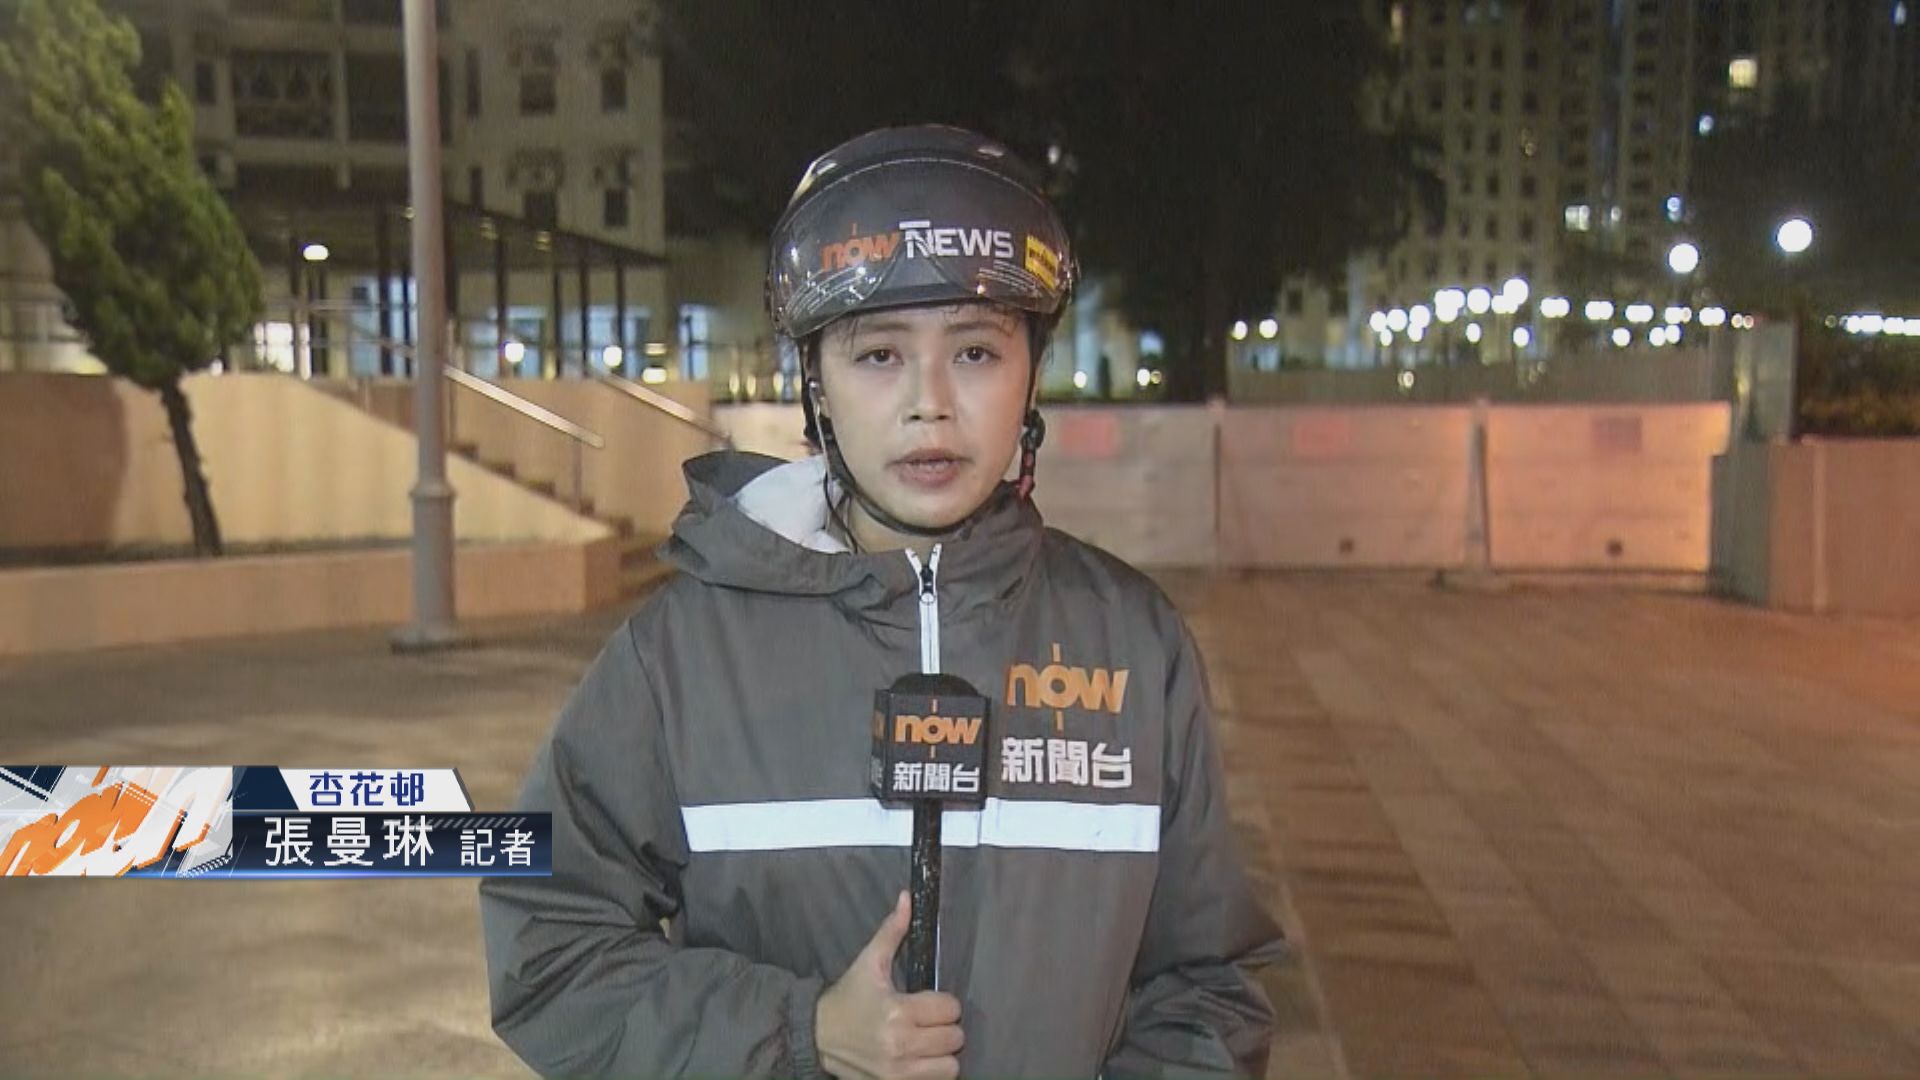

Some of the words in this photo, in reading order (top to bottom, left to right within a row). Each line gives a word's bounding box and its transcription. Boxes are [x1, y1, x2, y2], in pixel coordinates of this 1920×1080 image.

[822, 231, 900, 273] now
[900, 222, 1014, 259] NEWS
[1007, 663, 1130, 715] now
[894, 714, 983, 745] now
[892, 761, 981, 793] 新聞台
[1001, 736, 1134, 788] 新聞台
